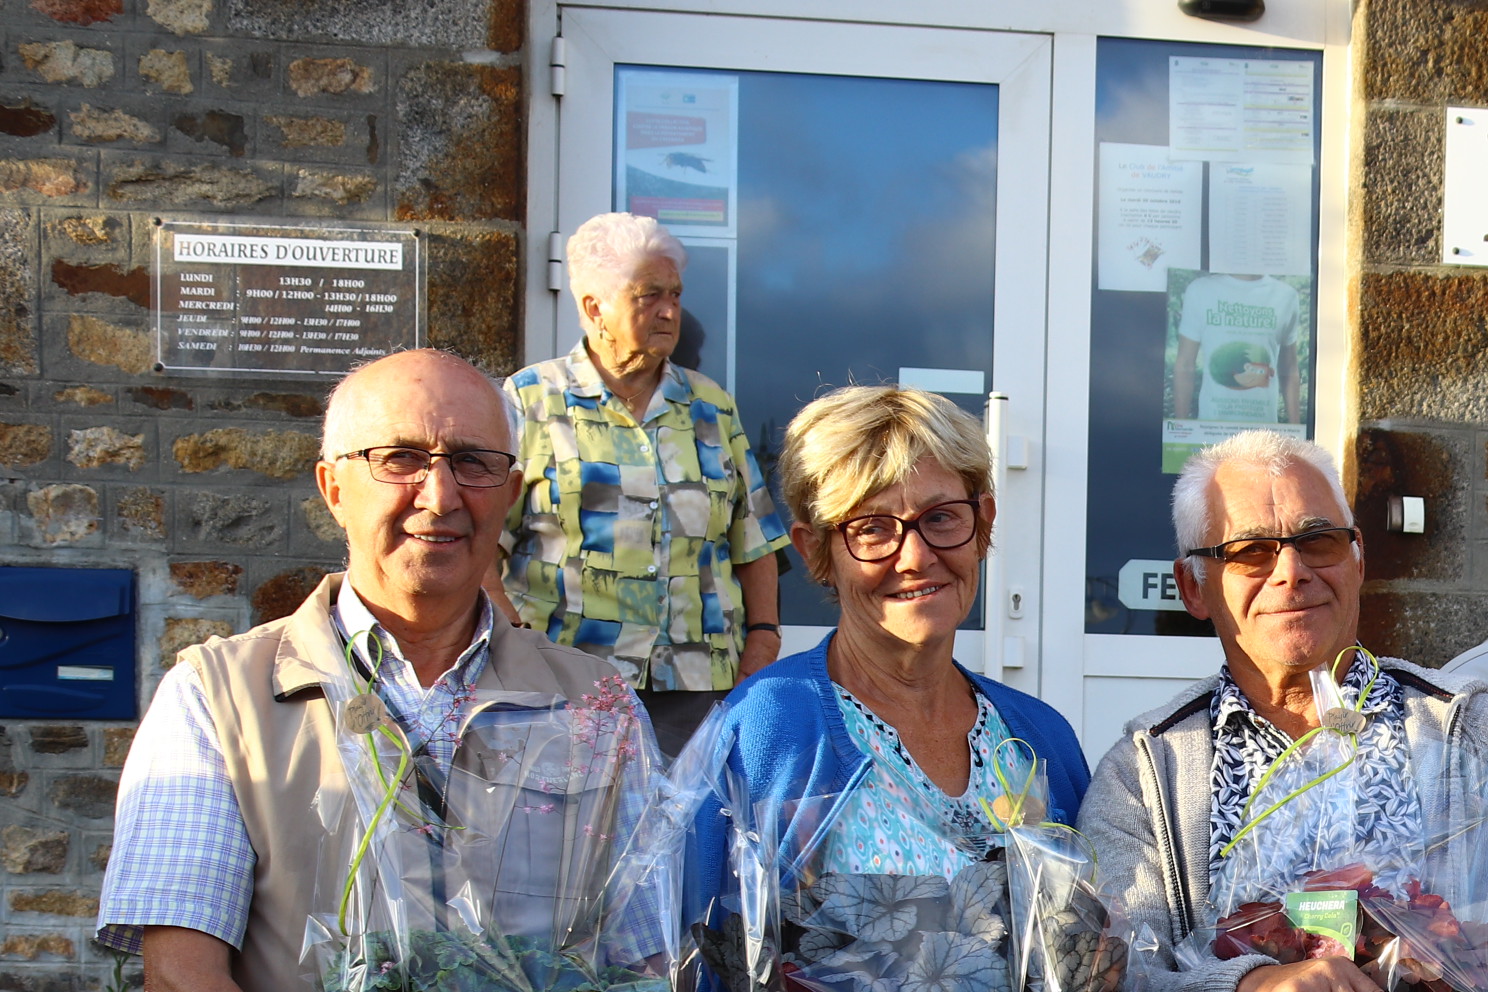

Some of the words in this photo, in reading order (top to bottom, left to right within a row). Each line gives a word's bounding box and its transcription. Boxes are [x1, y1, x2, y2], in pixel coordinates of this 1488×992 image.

[178, 241, 269, 259] HORAIRES
[275, 244, 398, 264] D'OUVERTURE
[180, 273, 213, 282] LUNDI
[279, 277, 312, 286] 13H30
[332, 279, 365, 288] 18H00
[180, 286, 215, 296] MARDI
[246, 289, 273, 298] 9H00
[282, 290, 314, 299] 12H00
[323, 292, 356, 301] 13H30
[365, 294, 397, 303] 18H00
[325, 304, 352, 313] 14H00
[365, 304, 393, 313] 16H30
[269, 317, 295, 325] 12H00
[177, 328, 229, 337] VENDREDI
[268, 330, 294, 338] 12H00
[177, 342, 217, 351] SAMEDI
[300, 345, 351, 355] Permanence
[1142, 572, 1182, 600] FE
[1298, 900, 1345, 911] HEUCHERA
